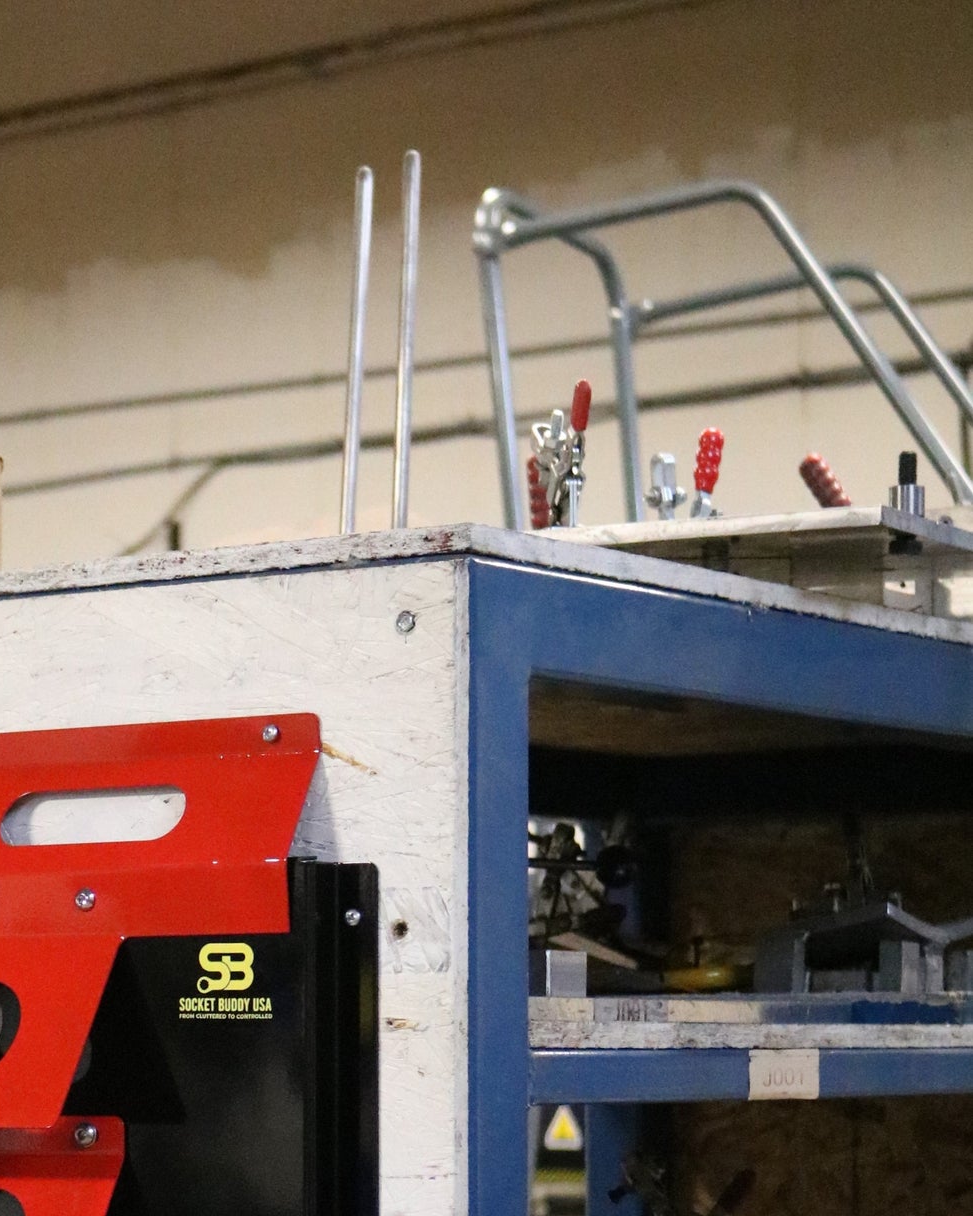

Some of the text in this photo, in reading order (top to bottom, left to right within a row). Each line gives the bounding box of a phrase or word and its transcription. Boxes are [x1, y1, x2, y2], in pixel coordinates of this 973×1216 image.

[197, 943, 254, 994] SB
[179, 997, 272, 1012] SOCKET BUDDY USA
